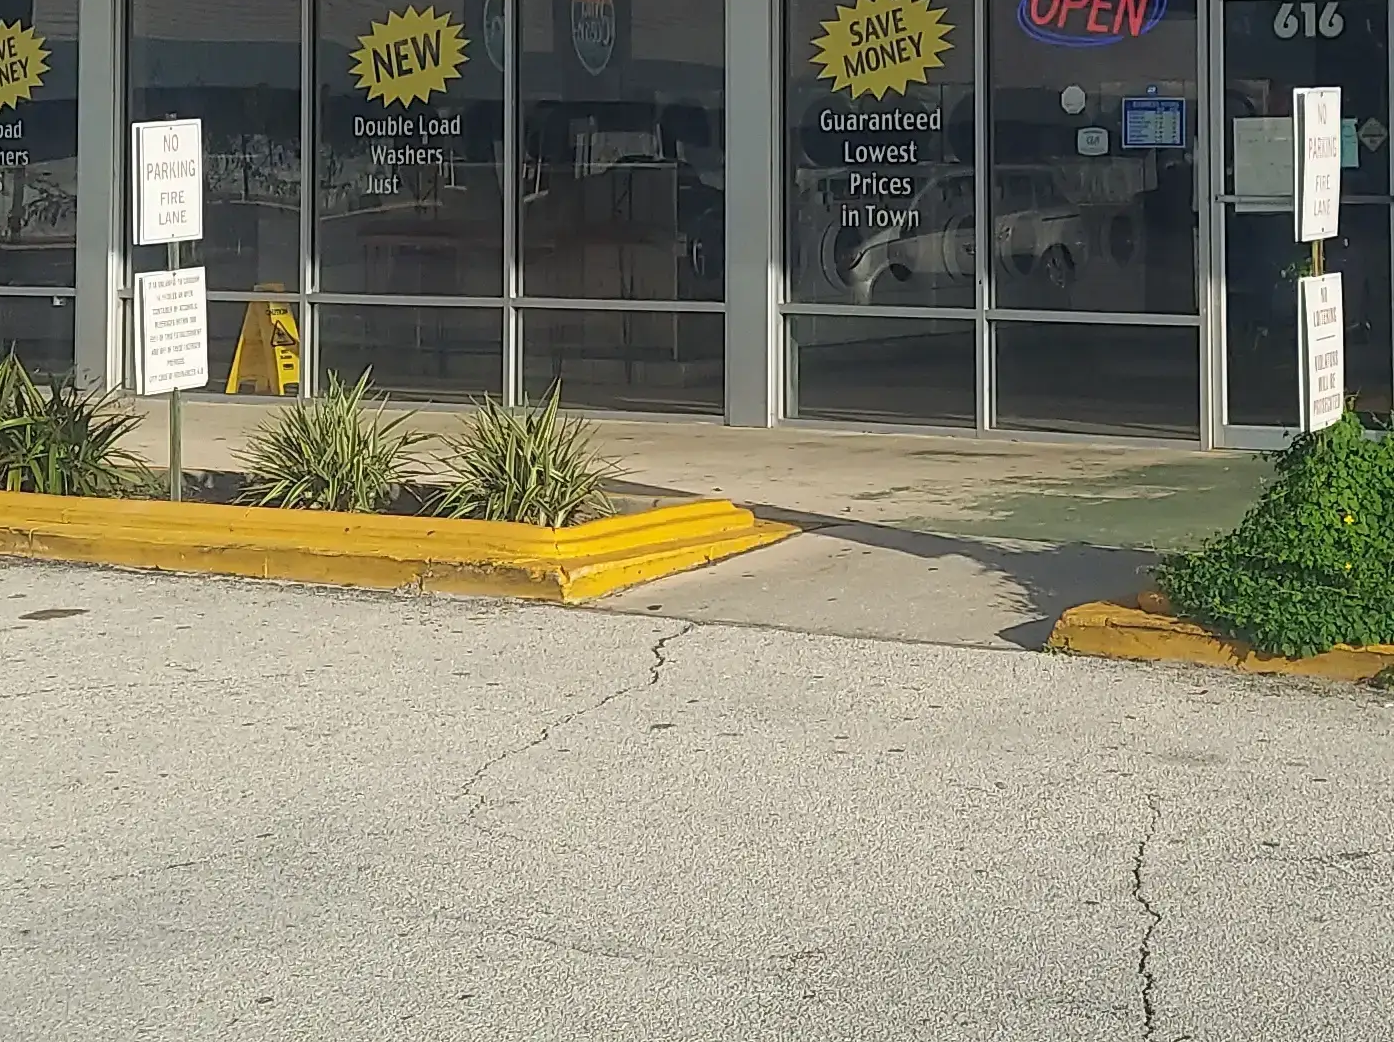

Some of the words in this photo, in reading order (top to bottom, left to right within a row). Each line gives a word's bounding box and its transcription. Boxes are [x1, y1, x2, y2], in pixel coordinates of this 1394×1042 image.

[849, 8, 906, 46] SAVE
[1273, 1, 1344, 38] 616
[372, 29, 441, 83] NEW
[843, 32, 923, 78] MONEY
[820, 108, 942, 132] Guaranteed
[1317, 103, 1327, 124] NO
[354, 115, 413, 136] Double
[419, 115, 461, 135] Load
[163, 134, 179, 152] NO
[844, 141, 918, 163] Lowest
[1308, 137, 1337, 159] PARKING
[371, 145, 443, 165] Washers
[147, 159, 196, 181] PARKING
[366, 174, 400, 194] Just
[850, 172, 912, 195] Prices
[160, 190, 185, 206] FIRE
[158, 210, 187, 225] LANE
[841, 204, 859, 227] in
[865, 205, 920, 227] Town
